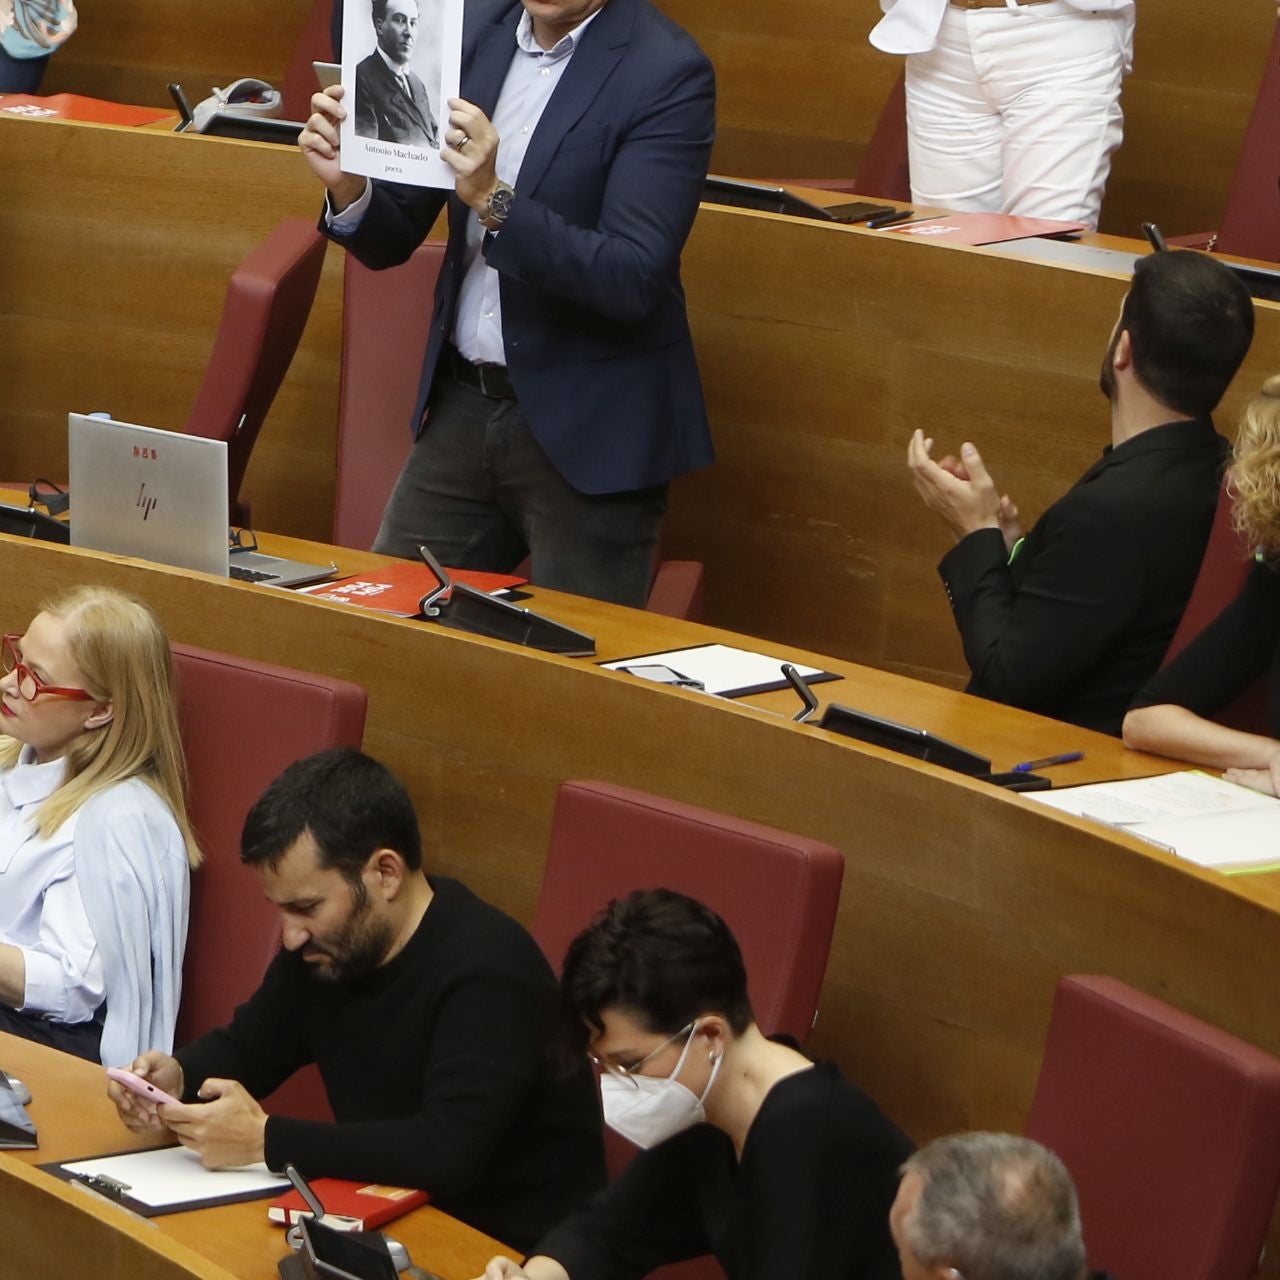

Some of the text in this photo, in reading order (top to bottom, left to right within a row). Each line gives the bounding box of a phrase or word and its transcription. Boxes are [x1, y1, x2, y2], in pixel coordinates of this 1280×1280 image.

[365, 144, 428, 162] Antonio Machado
[384, 165, 403, 174] poeta
[136, 483, 157, 521] hp
